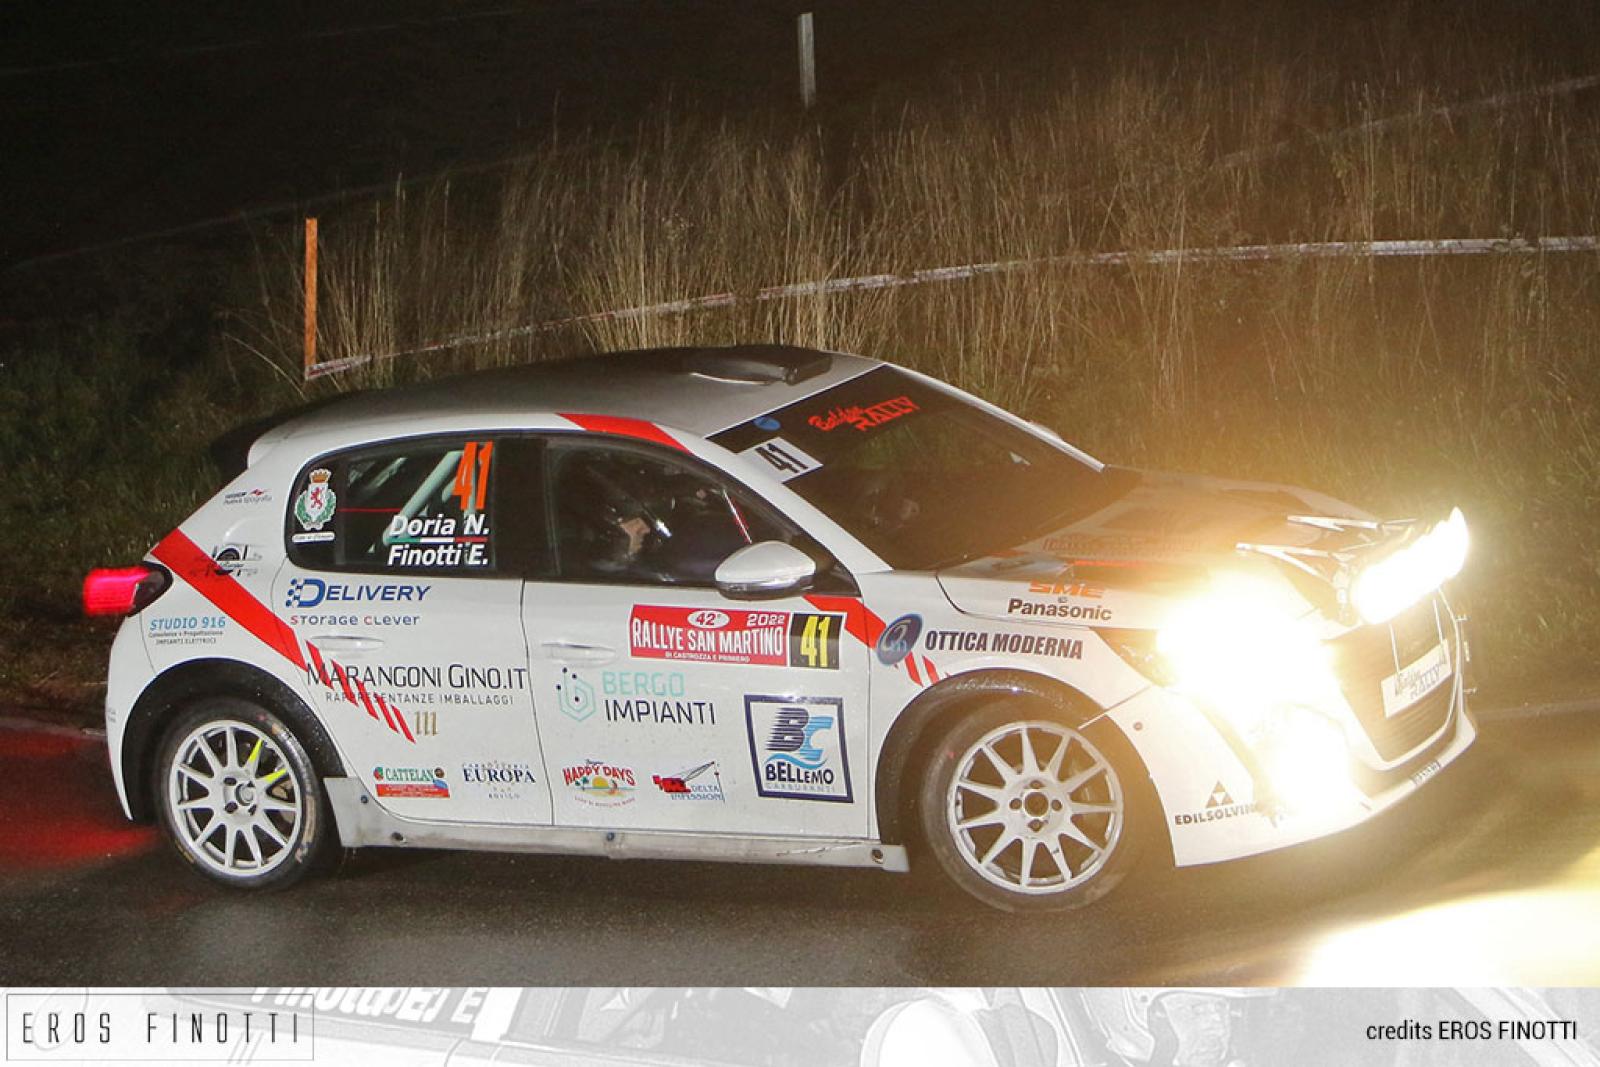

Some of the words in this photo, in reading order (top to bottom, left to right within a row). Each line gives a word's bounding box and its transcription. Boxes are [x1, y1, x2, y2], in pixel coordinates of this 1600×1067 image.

[755, 443, 809, 474] 41
[452, 441, 493, 510] 41
[389, 514, 456, 536] Doria
[464, 515, 490, 535] N.
[387, 544, 459, 566] Finotti
[467, 545, 489, 566] E.
[288, 579, 431, 607] DELIVERY
[747, 613, 785, 627] 2022
[1007, 597, 1112, 621] Panasonic
[150, 616, 198, 631] STUDIO
[202, 616, 226, 629] 916
[632, 618, 684, 651] RALLYE
[687, 628, 716, 653] SAN
[719, 626, 785, 656] MARTINO
[800, 615, 831, 667] 41
[925, 630, 987, 652] OTTICA
[992, 633, 1083, 660] MODERNA
[307, 663, 441, 689] MARANGONI
[602, 671, 685, 697] BERGO
[439, 693, 513, 705] IMBALLAGGI
[605, 699, 716, 726] IMPIANTI
[385, 767, 434, 782] CATTELAN
[463, 768, 537, 783] EUROPA
[562, 764, 600, 787] HAPPY
[602, 765, 637, 787] DAYS
[766, 761, 834, 784] BELLEMO
